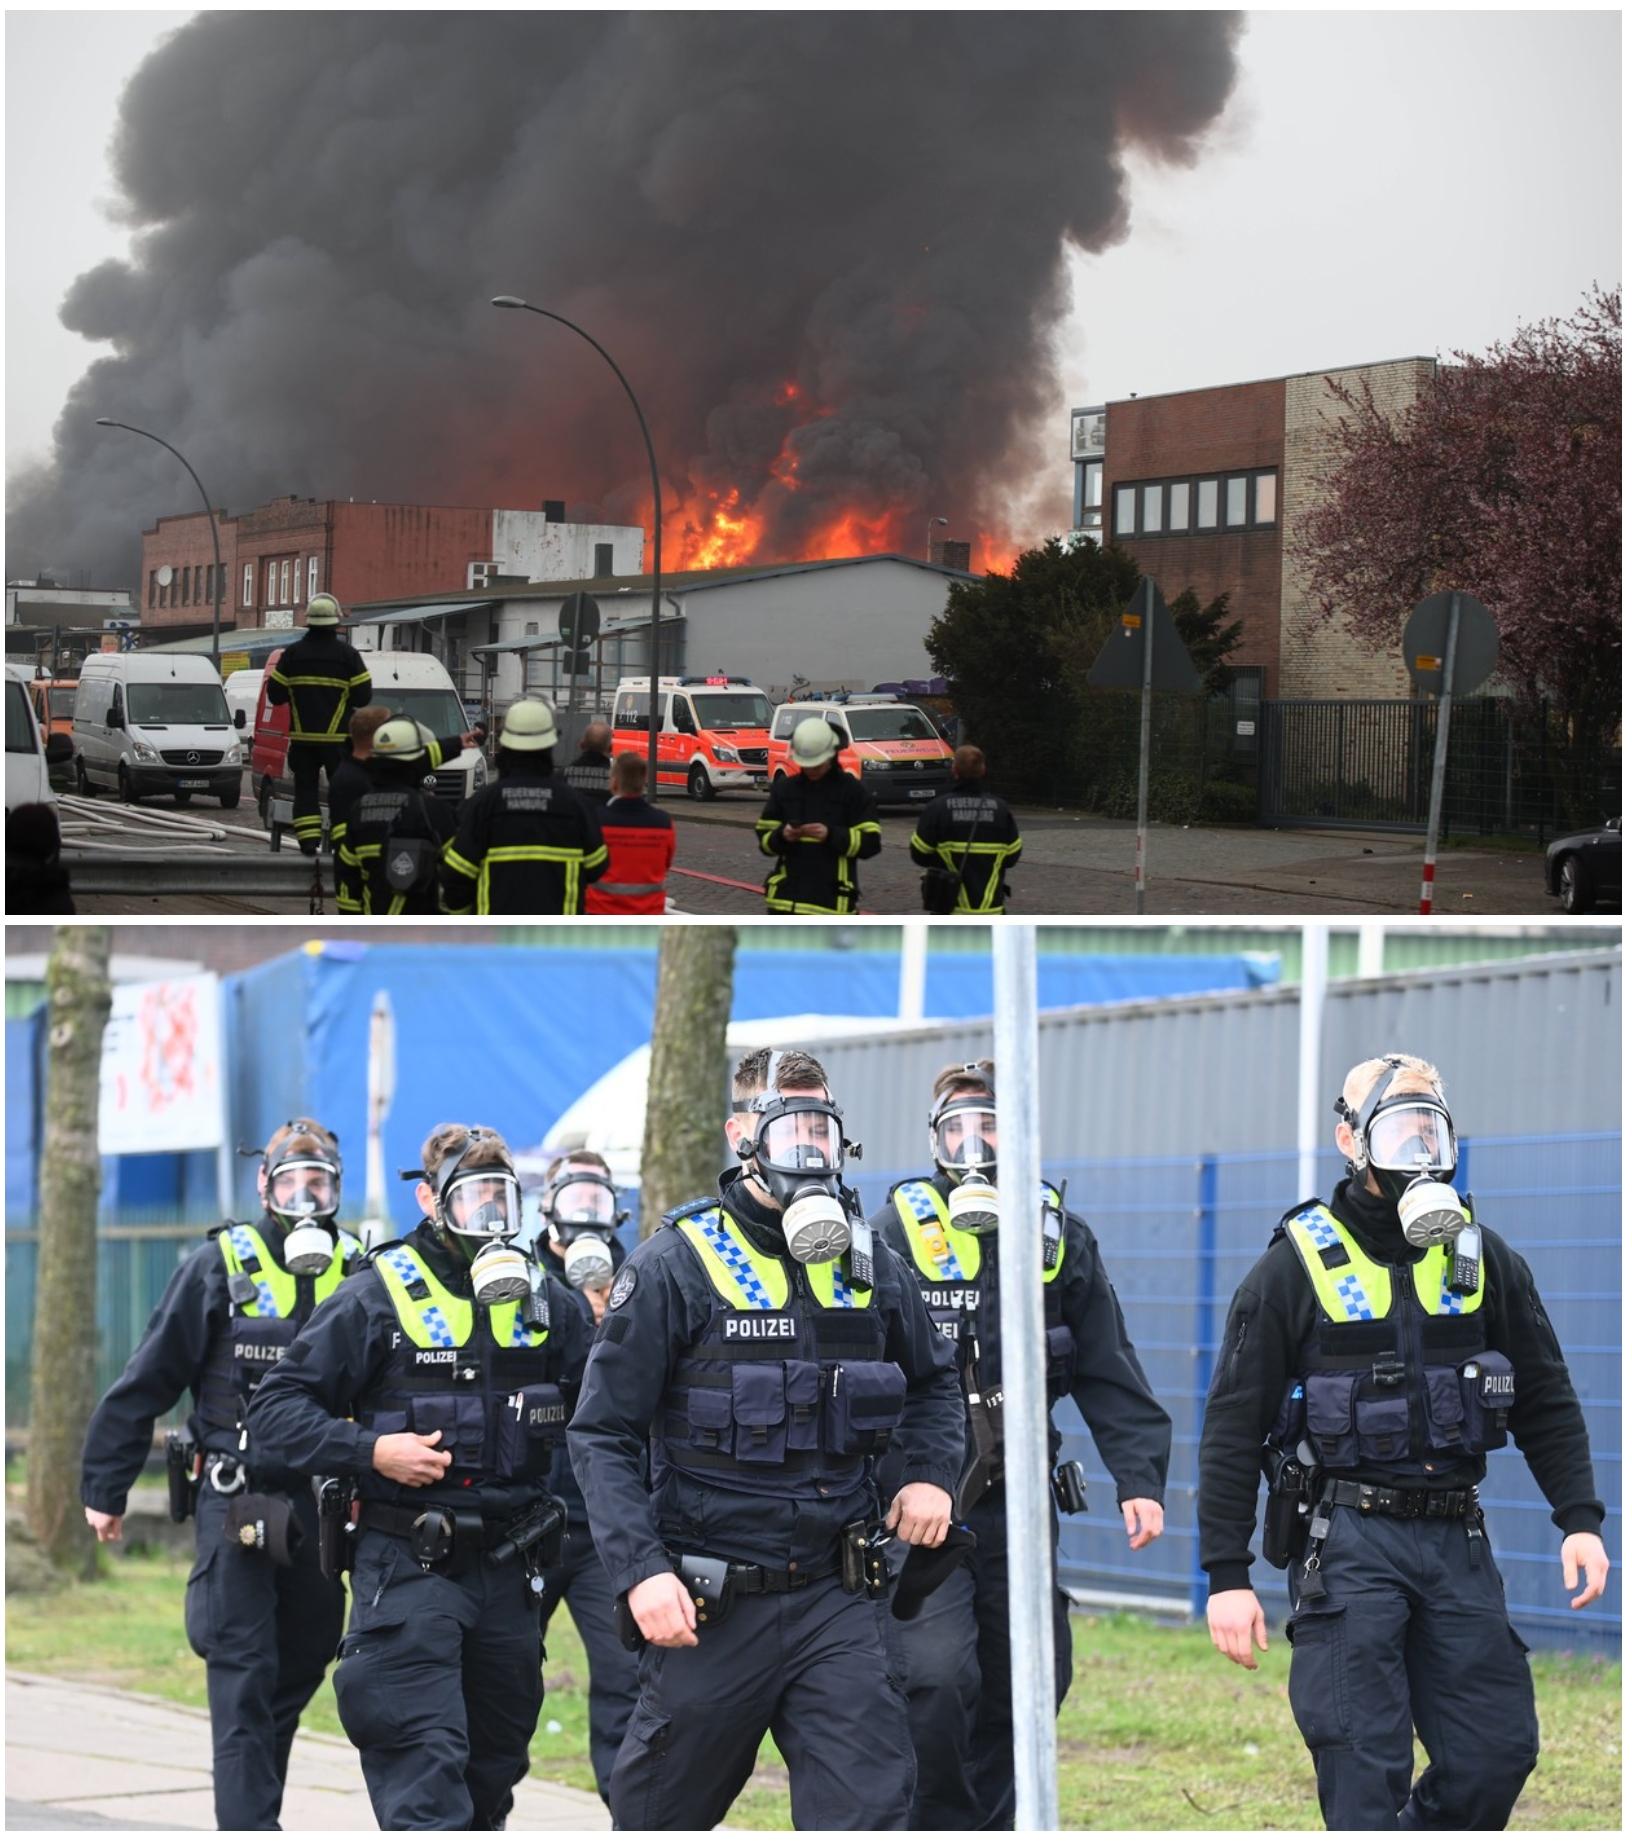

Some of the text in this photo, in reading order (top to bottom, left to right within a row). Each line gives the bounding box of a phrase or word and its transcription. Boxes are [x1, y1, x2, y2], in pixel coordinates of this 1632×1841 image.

[502, 787, 552, 799] FEUERWEHR
[507, 799, 548, 811] HAMBURG
[921, 1290, 979, 1306] POLIZEI
[726, 1318, 795, 1337] POLIZEI
[234, 1343, 286, 1360] POLIZE
[415, 1350, 457, 1364] POLIZEI
[529, 1405, 565, 1425] POLIZEI
